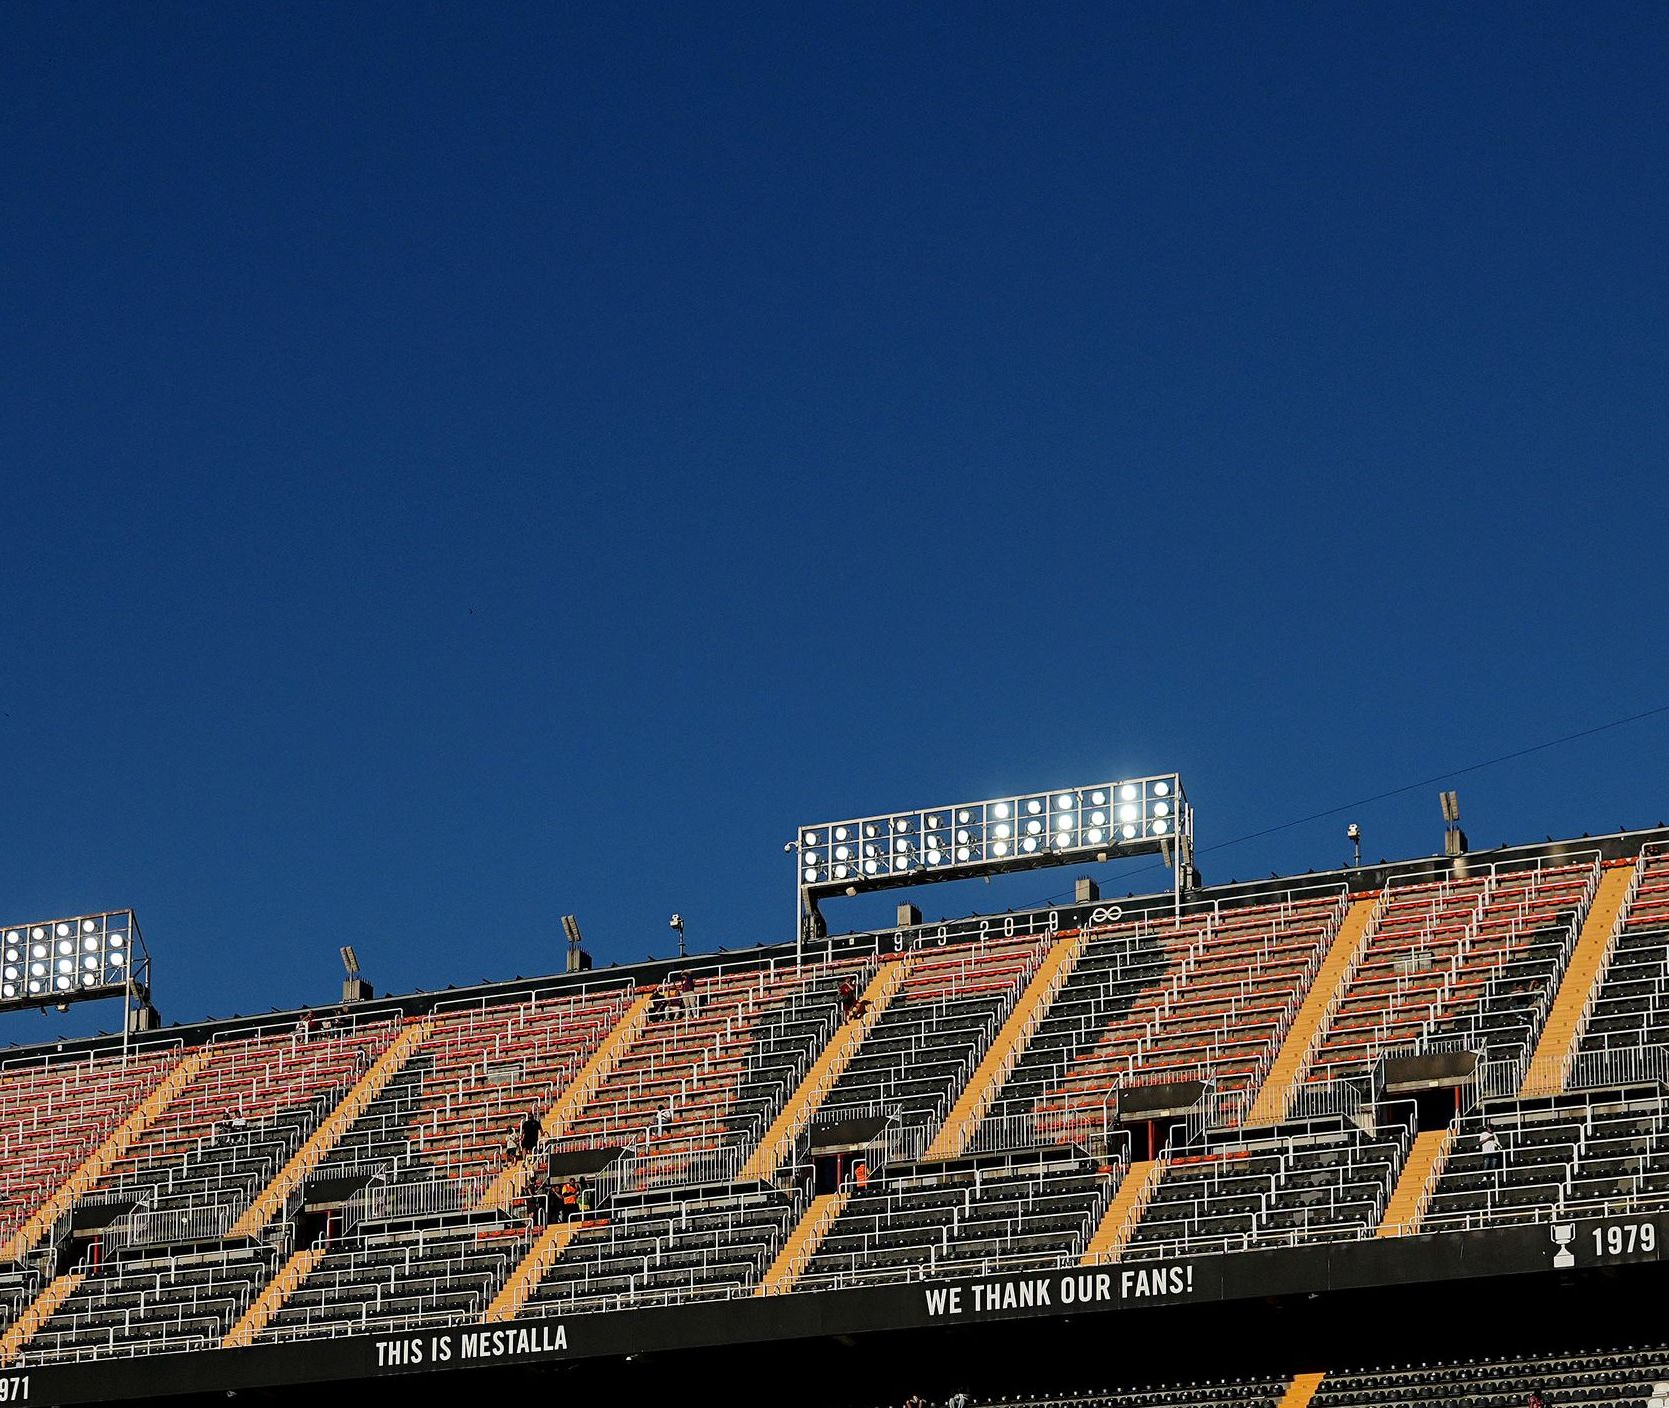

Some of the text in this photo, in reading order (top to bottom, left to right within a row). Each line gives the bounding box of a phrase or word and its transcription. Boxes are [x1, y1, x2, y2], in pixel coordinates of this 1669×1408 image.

[1593, 1224, 1659, 1259] 1979
[926, 1266, 1193, 1315] WE THANK OUR FANS!
[376, 1323, 567, 1366] THIS IS MESTALLA
